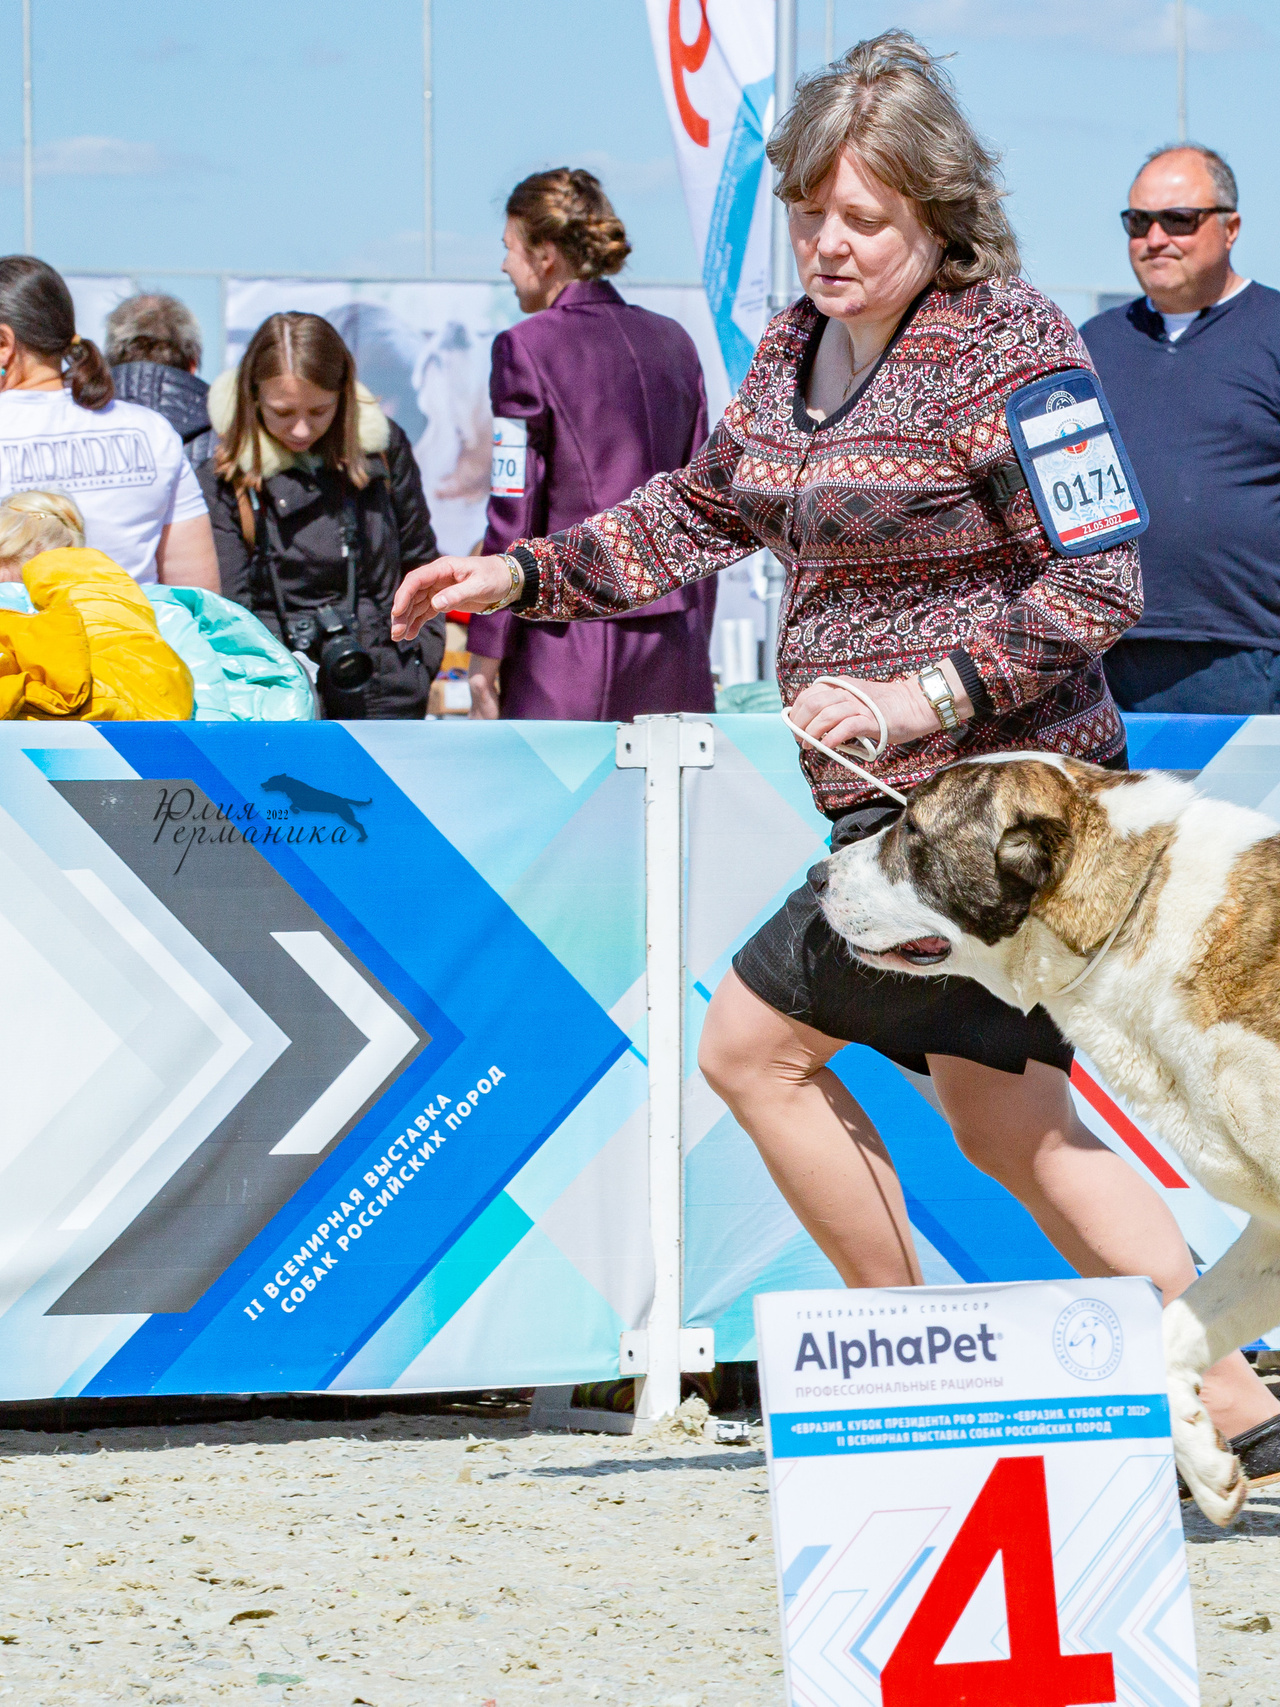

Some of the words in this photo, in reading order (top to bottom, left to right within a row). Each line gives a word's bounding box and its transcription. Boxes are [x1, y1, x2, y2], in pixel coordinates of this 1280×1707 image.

[492, 459, 516, 477] 70
[1052, 464, 1125, 512] 0171
[1082, 515, 1123, 534] 21.05.2022
[281, 1252, 338, 1313] СОБАК
[336, 1130, 447, 1252] РОССИЙСКИХ
[444, 1065, 506, 1131] ПОРОД
[243, 1299, 265, 1320] II
[263, 1188, 365, 1299] ВСЕМИРНАЯ
[363, 1094, 452, 1188] ВЫСТАВКА
[797, 1305, 908, 1319] ГЕНЕРАЛЬНЫЙ
[920, 1302, 990, 1314] СПОНСОР
[794, 1323, 998, 1379] AlphaPet
[795, 1380, 937, 1398] ПРОФЕССИОНАЛЬНЫЕ
[940, 1376, 1004, 1391] РАЦИОНЫ
[847, 1418, 882, 1431] КУБОК
[884, 1415, 951, 1429] ПРЕЗИДЕНТА
[953, 1413, 976, 1425] РКФ
[1068, 1405, 1103, 1418] КУБОК
[1105, 1405, 1126, 1417] СНГ
[847, 1432, 910, 1446] ВСЕМИРНАЯ
[912, 1429, 967, 1443] ВЫСТАВКА
[969, 1426, 1003, 1439] СОБАК
[1005, 1422, 1073, 1437] РОССИЙСКИХ
[1075, 1421, 1112, 1433] ПОРОД
[880, 1455, 1117, 1707] 4
